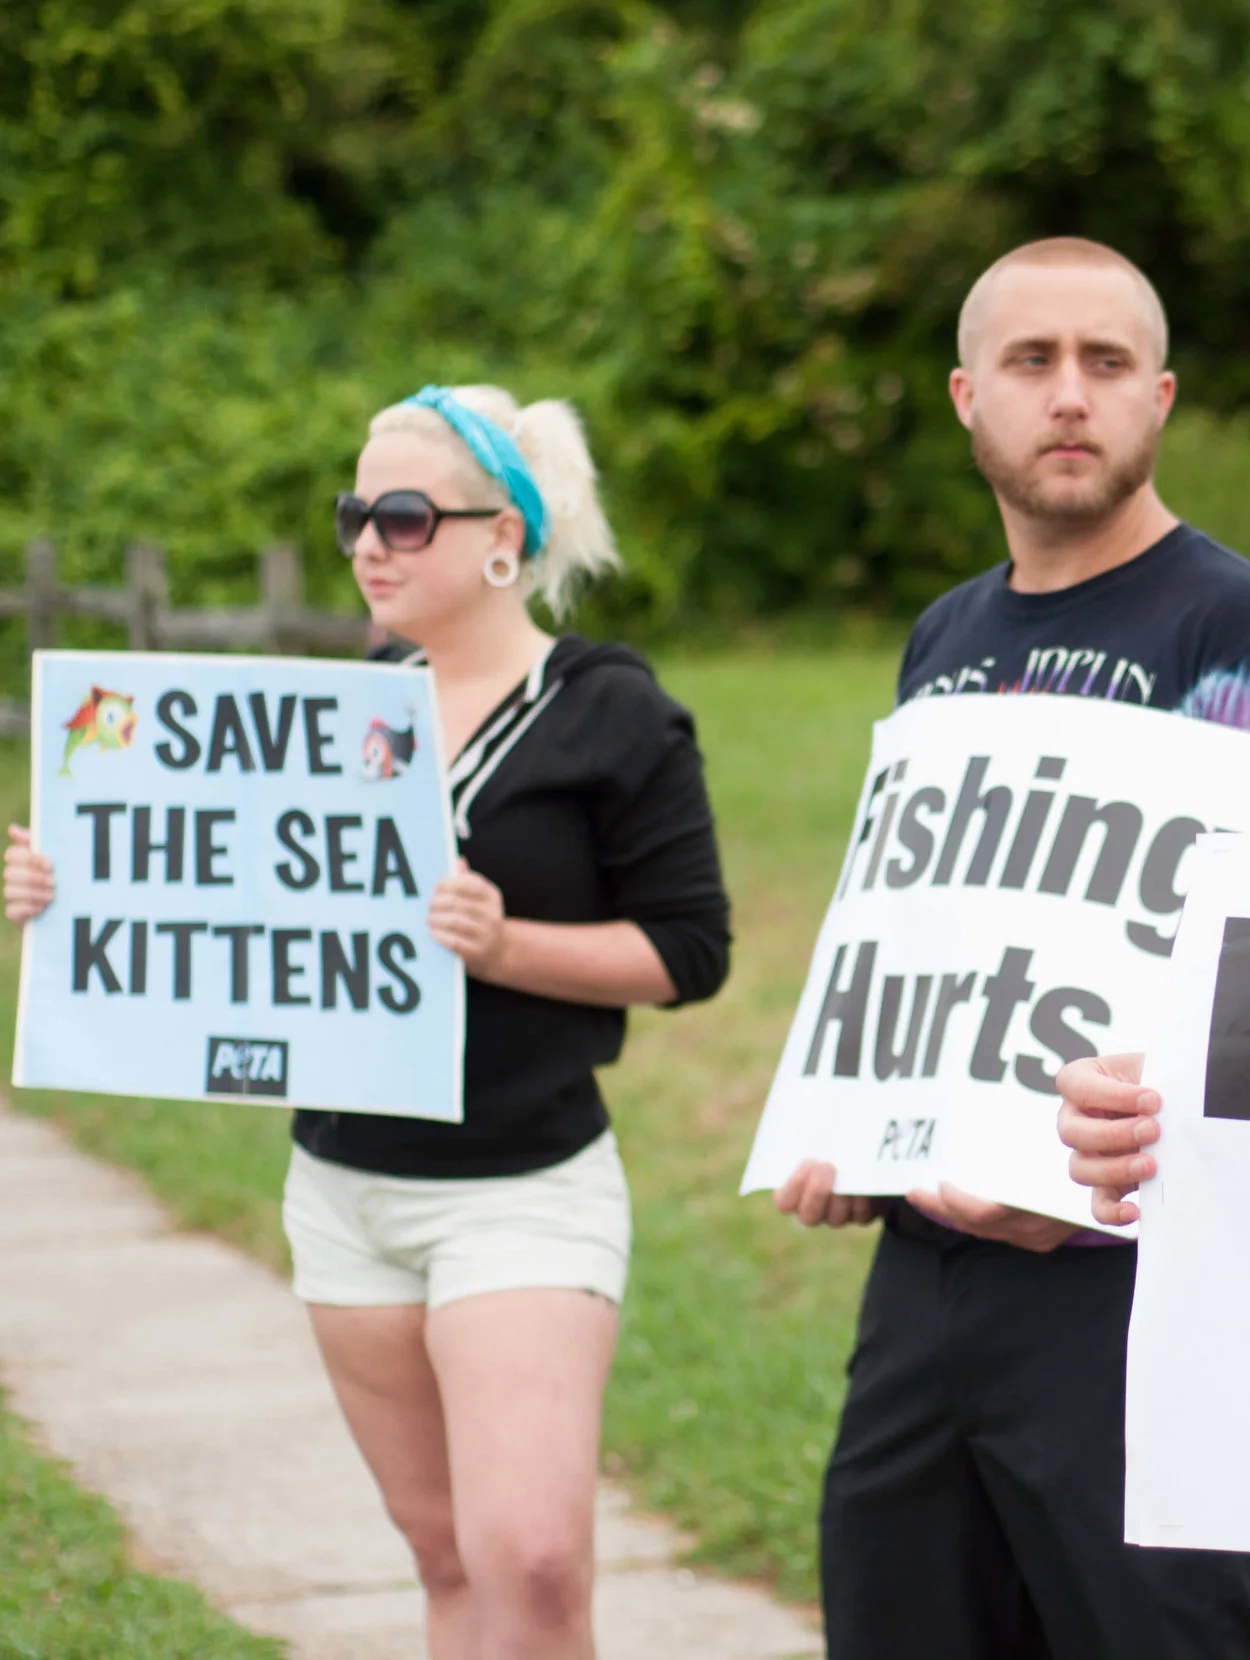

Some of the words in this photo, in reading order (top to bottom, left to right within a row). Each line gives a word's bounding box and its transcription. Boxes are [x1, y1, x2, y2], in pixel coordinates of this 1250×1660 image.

[154, 689, 343, 775] SAVE
[77, 803, 236, 886] THE
[275, 810, 419, 897] SEA
[72, 916, 422, 1016] KITTENS
[803, 940, 1112, 1098] Hurts
